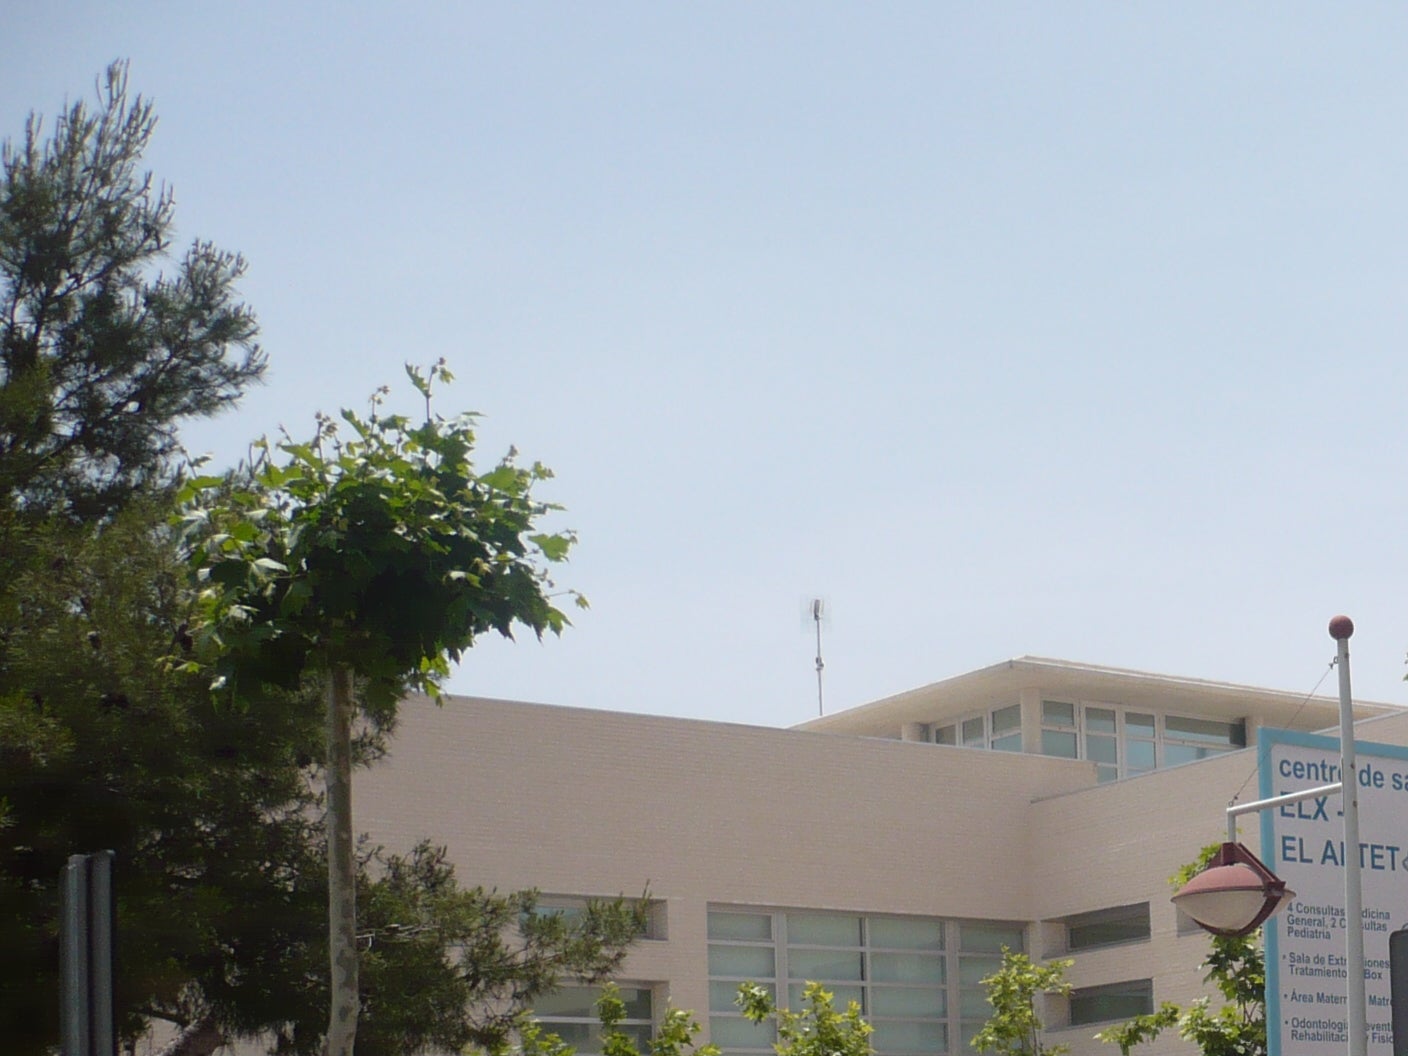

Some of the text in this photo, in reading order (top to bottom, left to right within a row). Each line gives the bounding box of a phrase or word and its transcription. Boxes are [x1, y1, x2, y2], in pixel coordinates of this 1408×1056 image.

[1279, 759, 1343, 783] centr
[1359, 764, 1385, 789] de
[1281, 835, 1313, 863] EL
[1287, 902, 1294, 912] 4
[1296, 903, 1346, 917] Consultas
[1331, 918, 1337, 928] 2
[1289, 952, 1310, 964] Sala
[1313, 954, 1326, 965] de
[1363, 968, 1383, 980] Box
